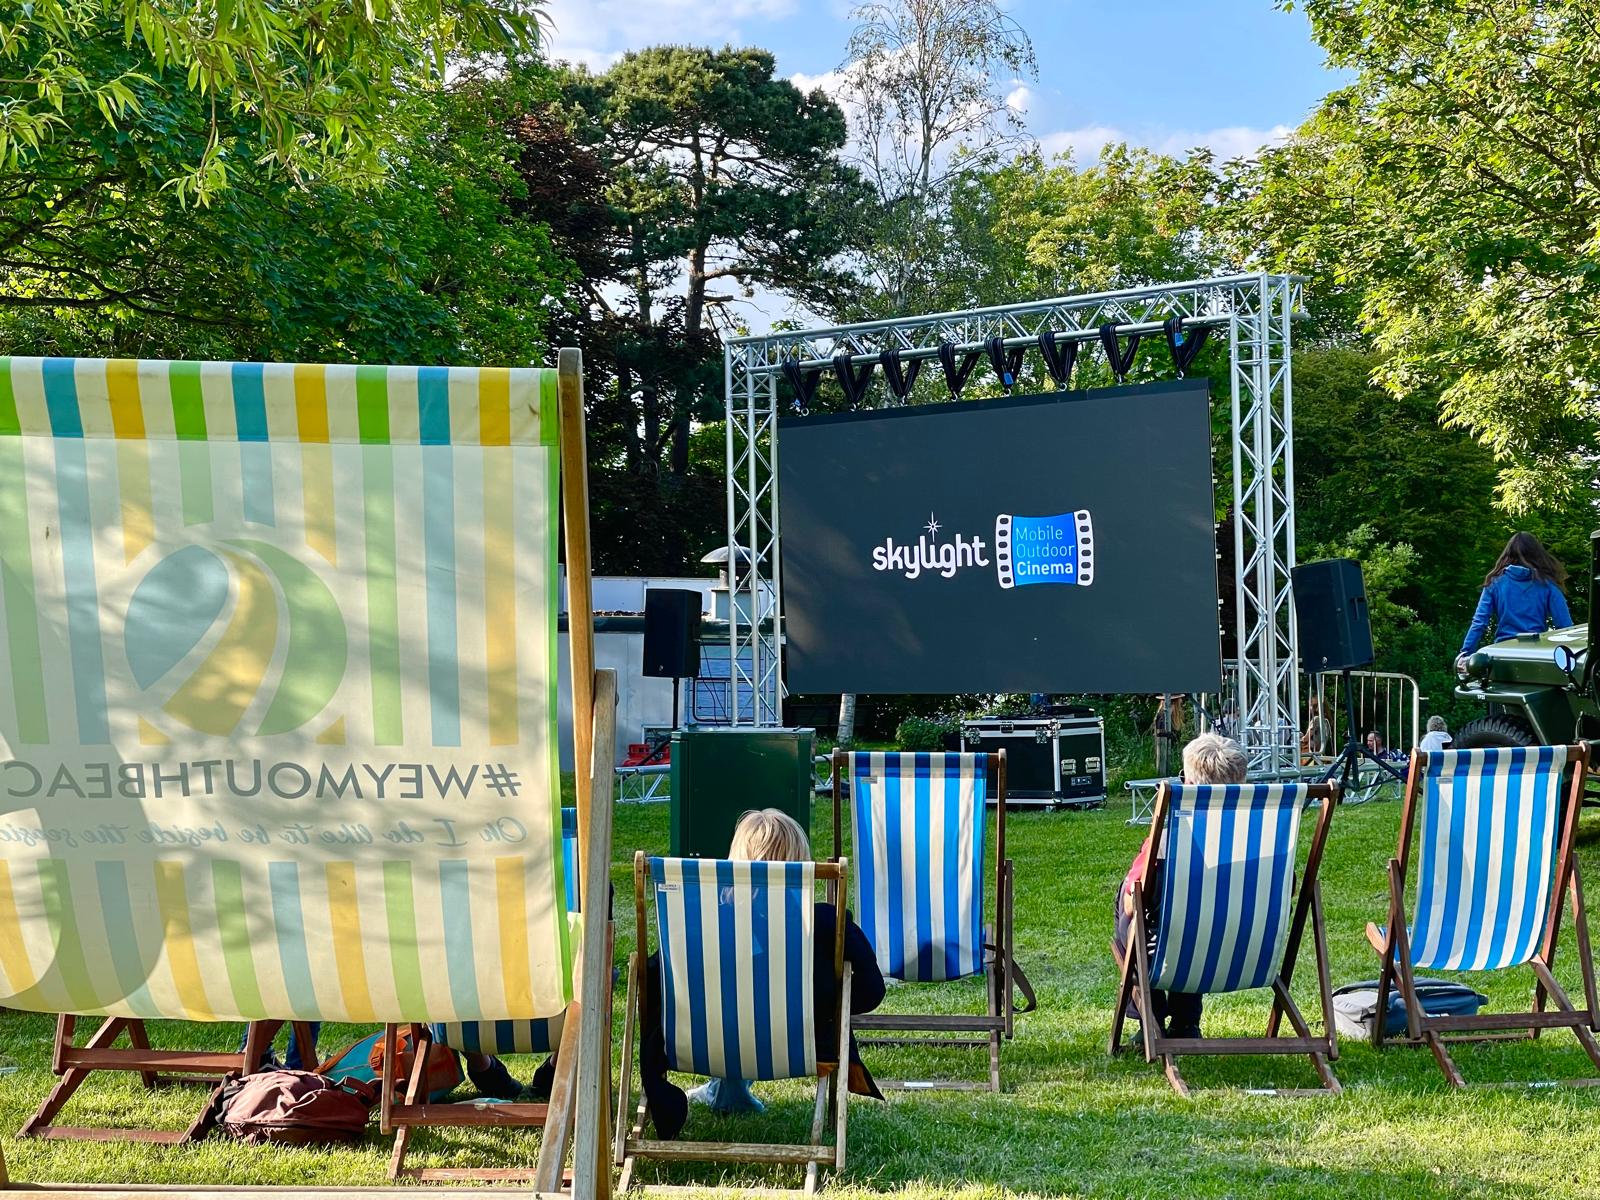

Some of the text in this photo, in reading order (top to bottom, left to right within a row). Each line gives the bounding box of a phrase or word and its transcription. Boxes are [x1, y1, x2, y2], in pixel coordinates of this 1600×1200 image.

[1015, 526, 1063, 541] Mobile
[872, 533, 989, 579] skylight
[1016, 544, 1074, 559] Outdoor
[1016, 561, 1074, 576] Cinema
